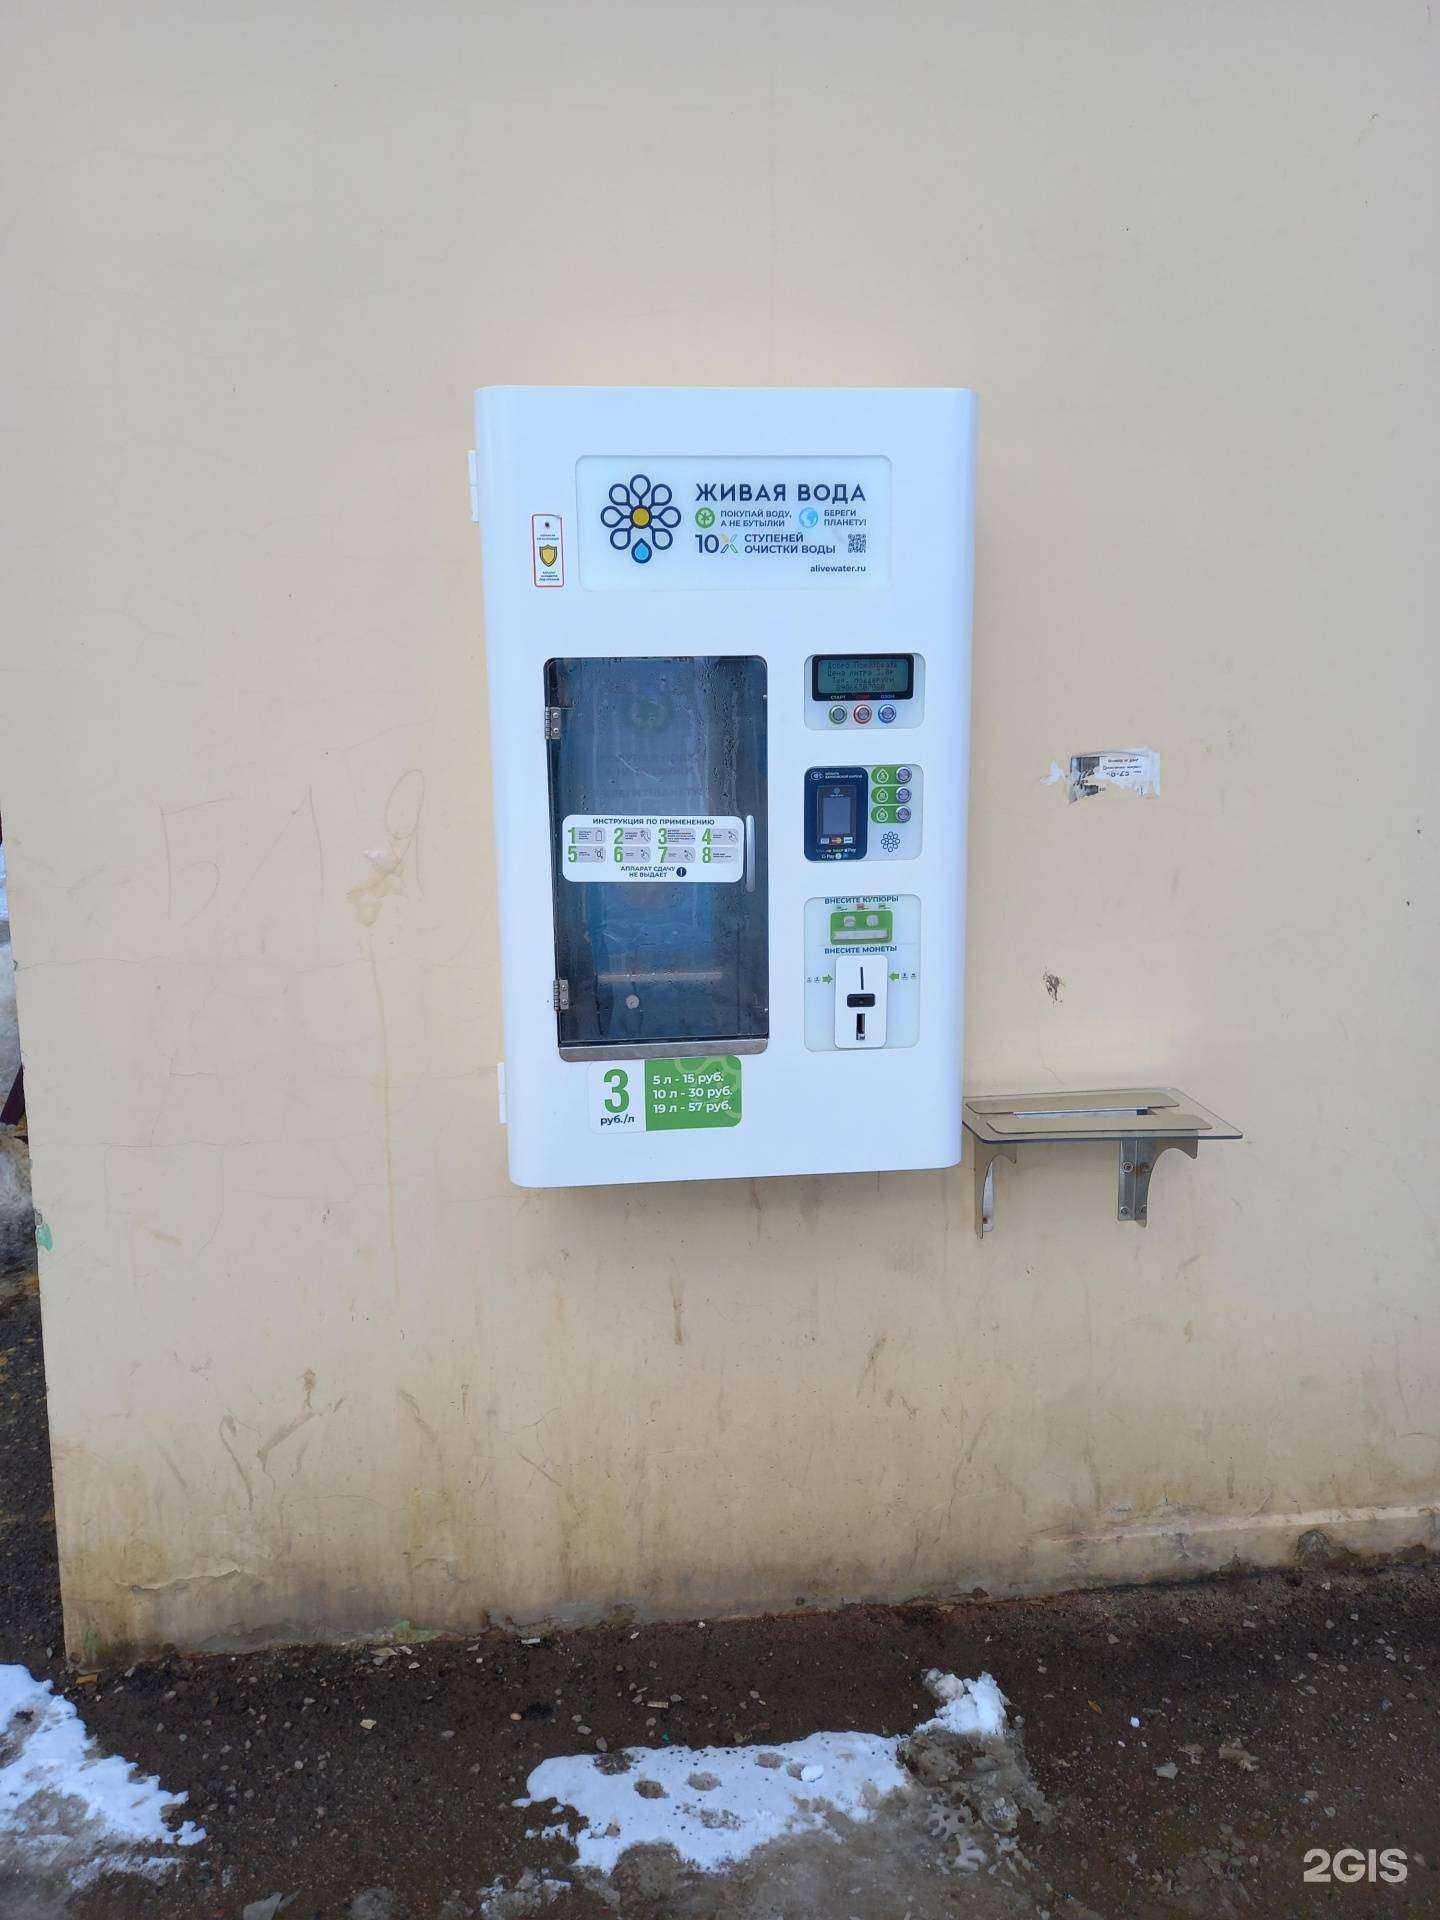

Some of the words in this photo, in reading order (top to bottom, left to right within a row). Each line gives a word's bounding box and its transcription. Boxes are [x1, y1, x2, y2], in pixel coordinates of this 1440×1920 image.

[695, 483, 786, 501] ЖИВАЯ
[798, 483, 866, 504] ВОДА
[721, 508, 764, 518] ПОКУПАЙ
[766, 510, 792, 519] ВОДУ,
[824, 509, 856, 517] БЕРЕГИ
[743, 519, 785, 527] БУТЫЛКИ
[824, 518, 867, 526] ПЛАНЕТУ!
[744, 532, 804, 543] СТУПЕНЕЙ
[744, 545, 798, 554] ОЧИСТКИ
[802, 545, 836, 555] ВОДЫ
[810, 564, 866, 572] alivewater.ru
[567, 827, 577, 843] 1
[614, 828, 624, 844] 2
[658, 828, 667, 845] 3
[702, 828, 712, 845] 4
[567, 846, 578, 862] 5
[614, 846, 623, 863] 6
[658, 847, 668, 863] 7
[702, 847, 712, 863] 8
[825, 896, 861, 904] ВНЕСИТЕ
[863, 895, 899, 903] КУПЮРЫ
[862, 945, 898, 953] МОНЕТЫ
[652, 1075, 660, 1085] 5
[663, 1076, 672, 1084] л
[683, 1073, 694, 1083] 15
[698, 1072, 724, 1085] руб.
[603, 1068, 630, 1113] 3
[652, 1089, 666, 1099] 10
[669, 1090, 677, 1099] л
[688, 1088, 703, 1098] 30
[707, 1086, 733, 1098] руб.
[653, 1104, 666, 1114] 19
[669, 1104, 677, 1112] л
[688, 1102, 702, 1112] 57
[706, 1101, 732, 1113] руб.
[600, 1114, 635, 1126] руб./л
